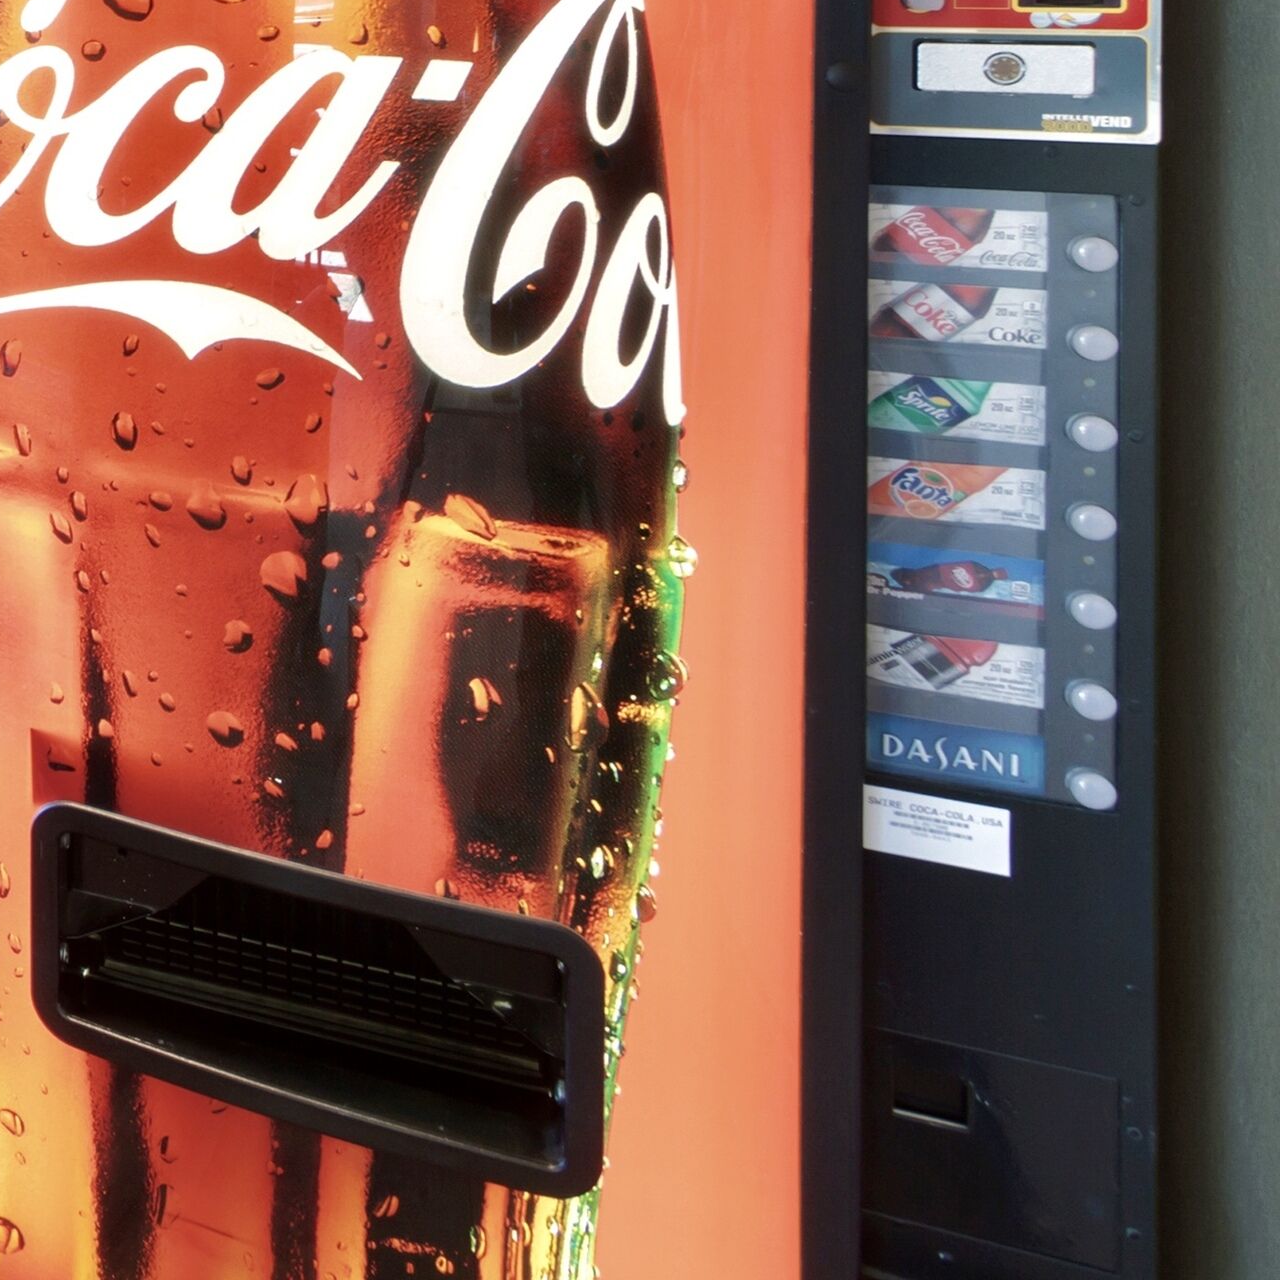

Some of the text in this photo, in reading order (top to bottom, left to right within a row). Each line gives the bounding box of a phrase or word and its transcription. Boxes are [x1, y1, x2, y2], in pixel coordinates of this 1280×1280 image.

[993, 230, 1006, 240] 20
[903, 287, 957, 336] Coke
[995, 307, 1008, 317] 20
[988, 326, 1042, 345] Coke
[897, 390, 950, 420] Sprite
[991, 402, 1004, 412] 20
[891, 467, 953, 507] Fanta
[991, 485, 1004, 495] 20
[882, 733, 1019, 778] DASANI
[867, 796, 903, 810] SWIRE
